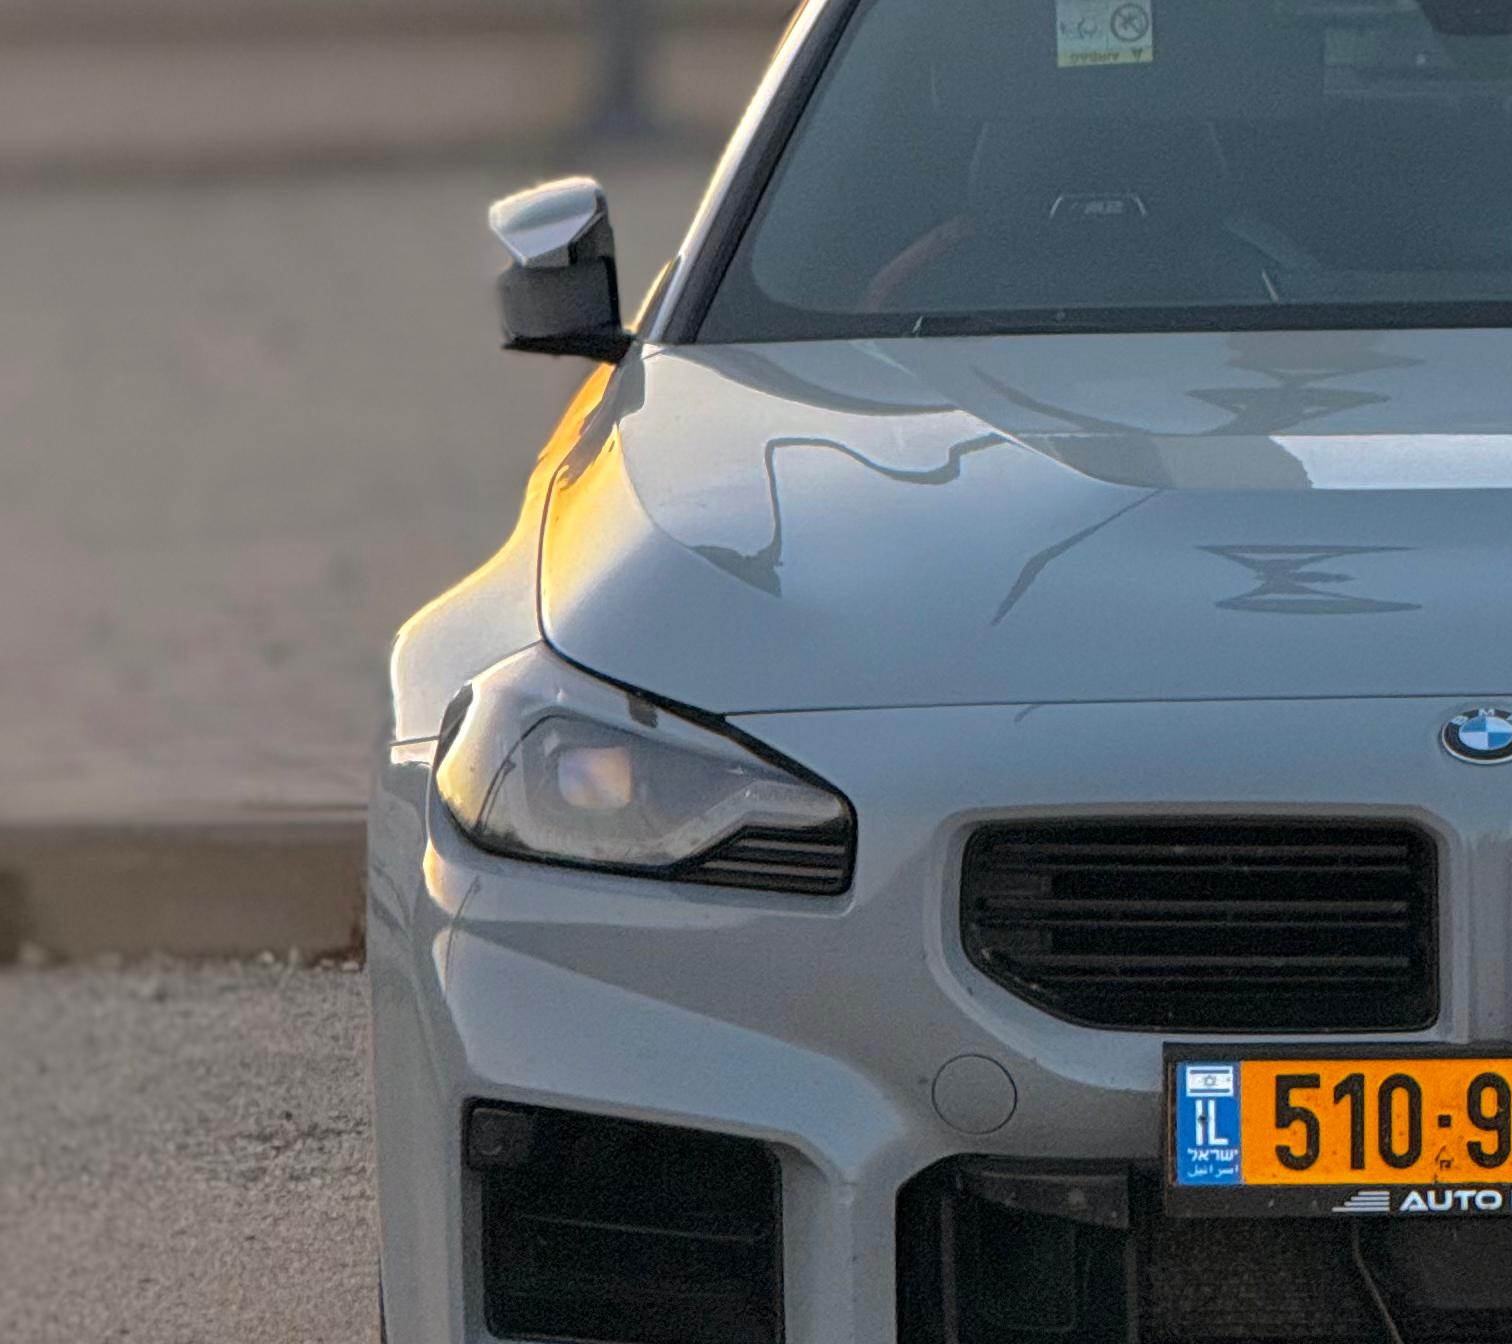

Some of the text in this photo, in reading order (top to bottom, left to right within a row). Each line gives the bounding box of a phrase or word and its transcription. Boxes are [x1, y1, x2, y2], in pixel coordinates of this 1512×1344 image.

[1195, 1099, 1228, 1146] IL
[1187, 1148, 1239, 1162] ישראל
[1400, 1190, 1503, 1211] AUTO
